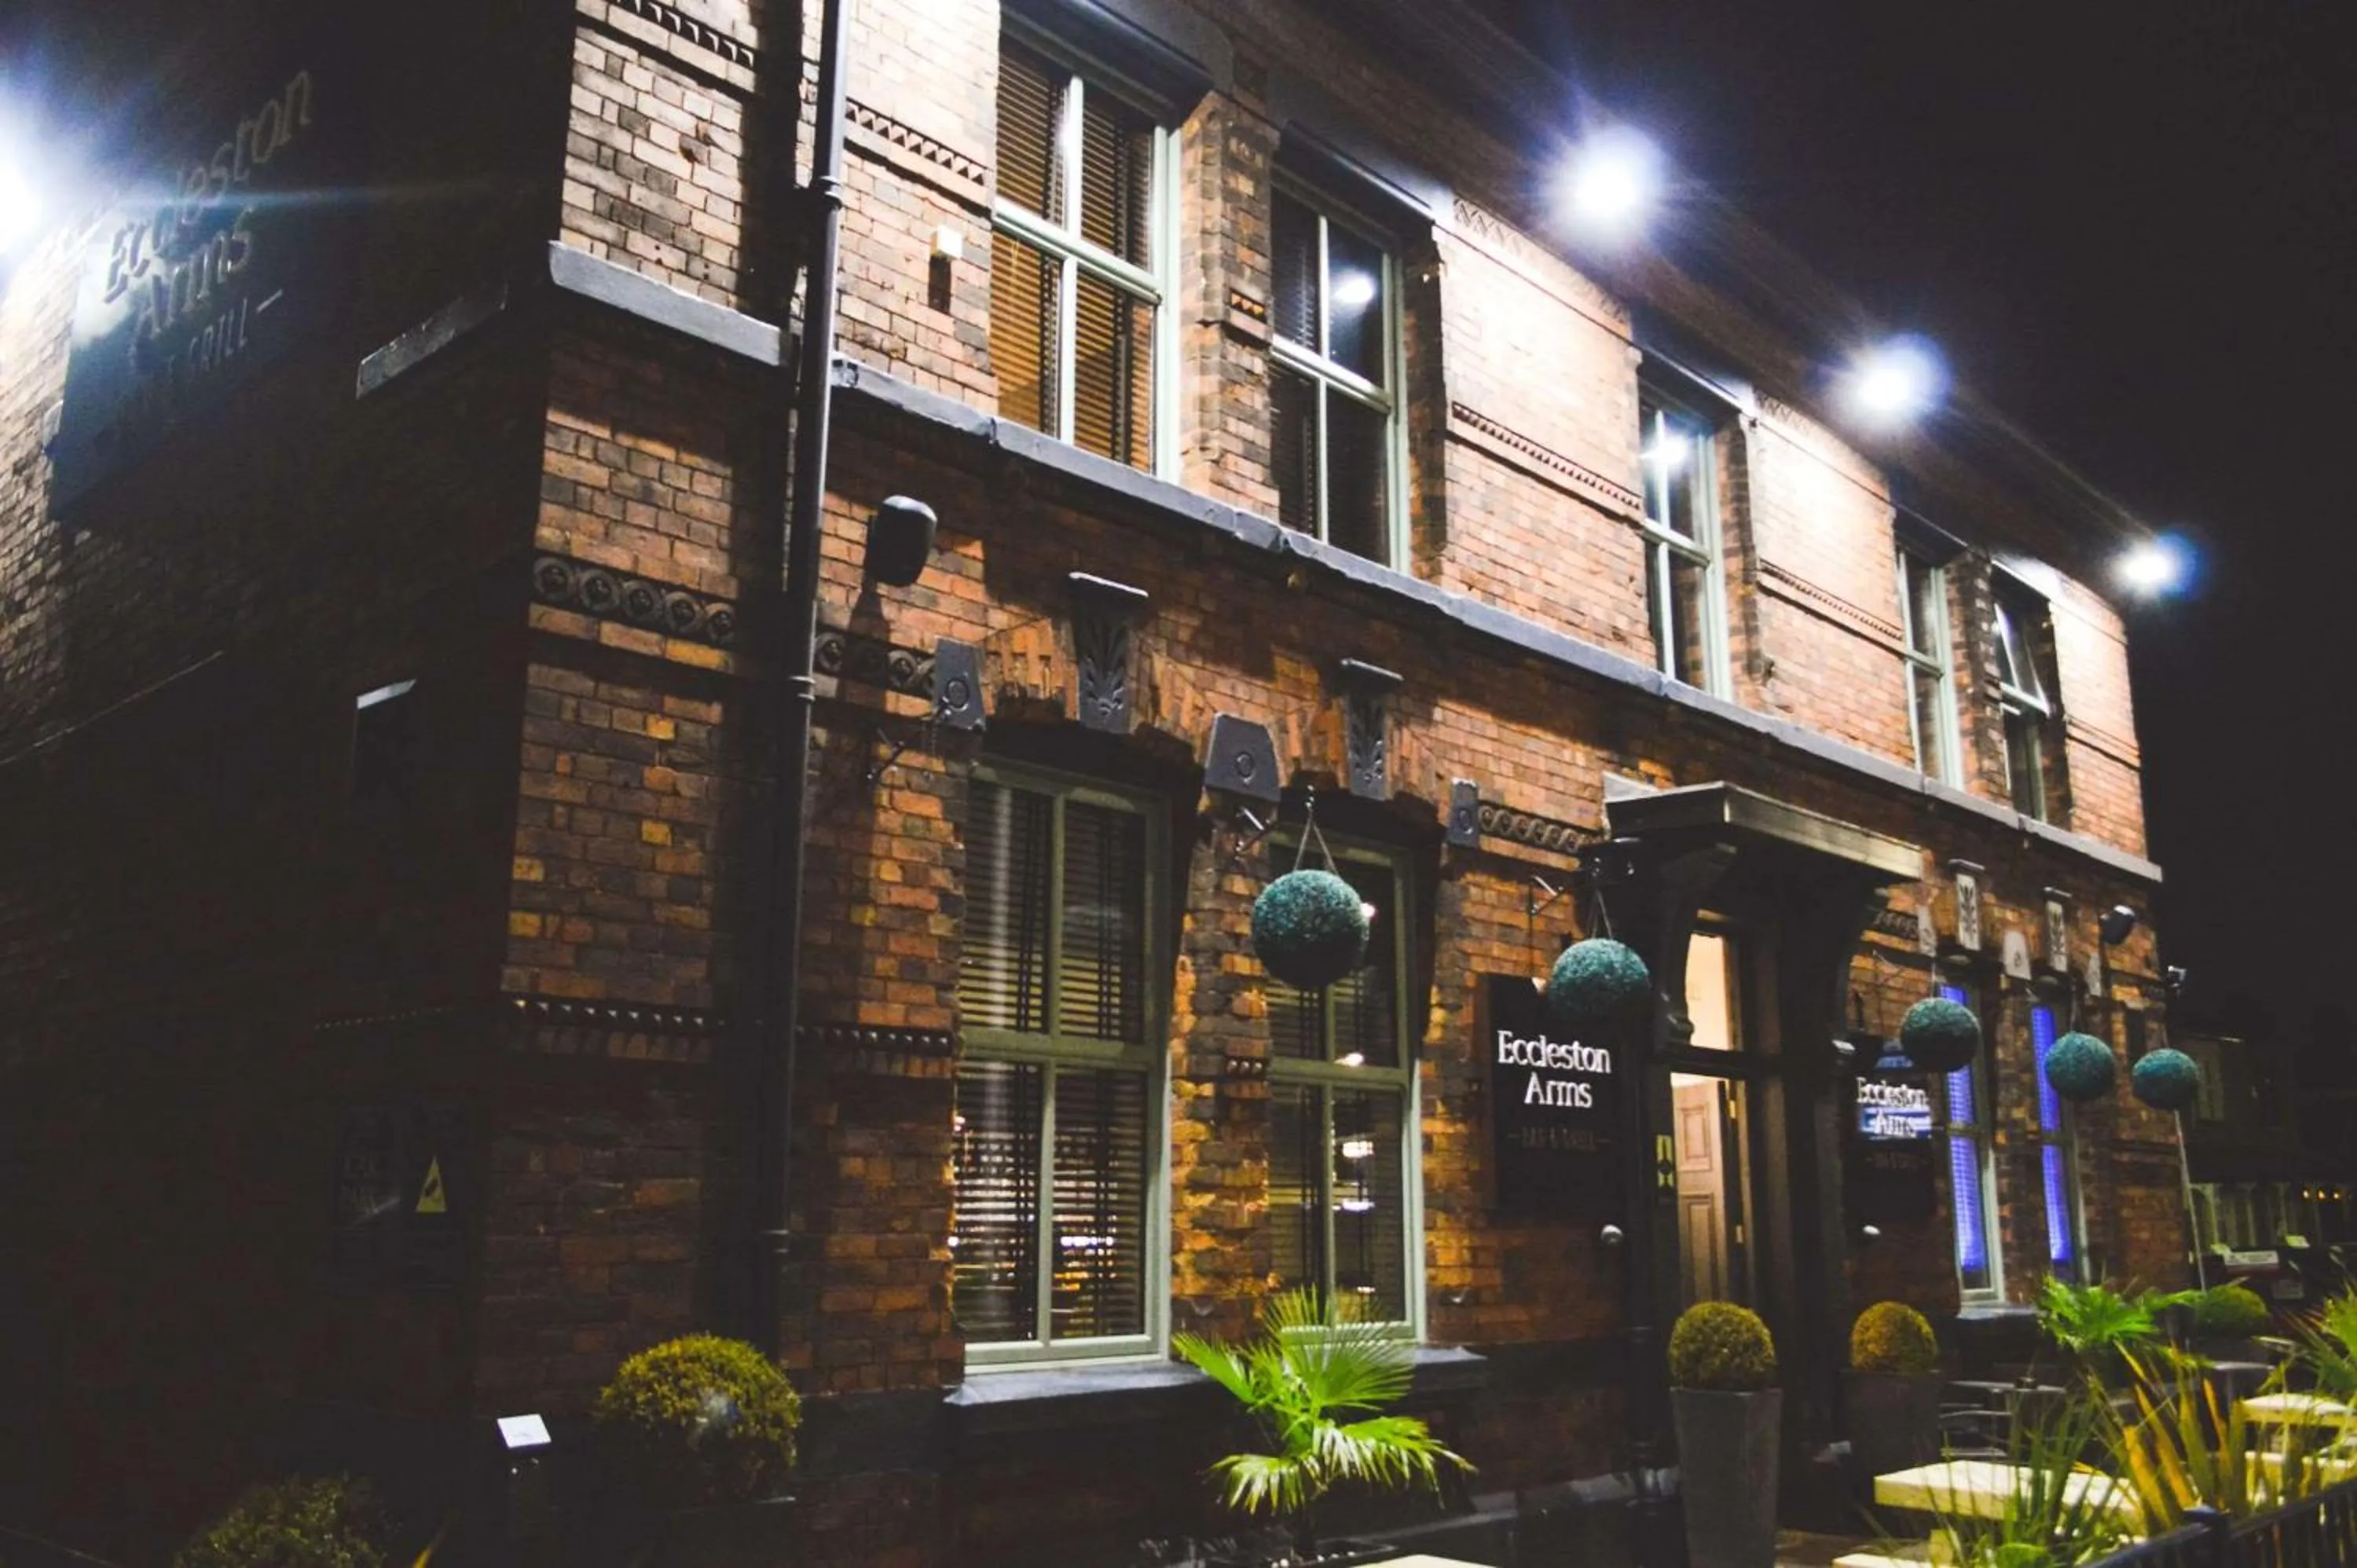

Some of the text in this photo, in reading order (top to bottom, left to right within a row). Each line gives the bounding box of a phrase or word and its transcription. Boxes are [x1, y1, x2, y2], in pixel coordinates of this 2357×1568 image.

[1497, 1030, 1612, 1074] Eccleston
[1523, 1071, 1593, 1108] Arms
[1856, 1075, 1930, 1111] Eccleston
[1874, 1108, 1917, 1138] Arms
